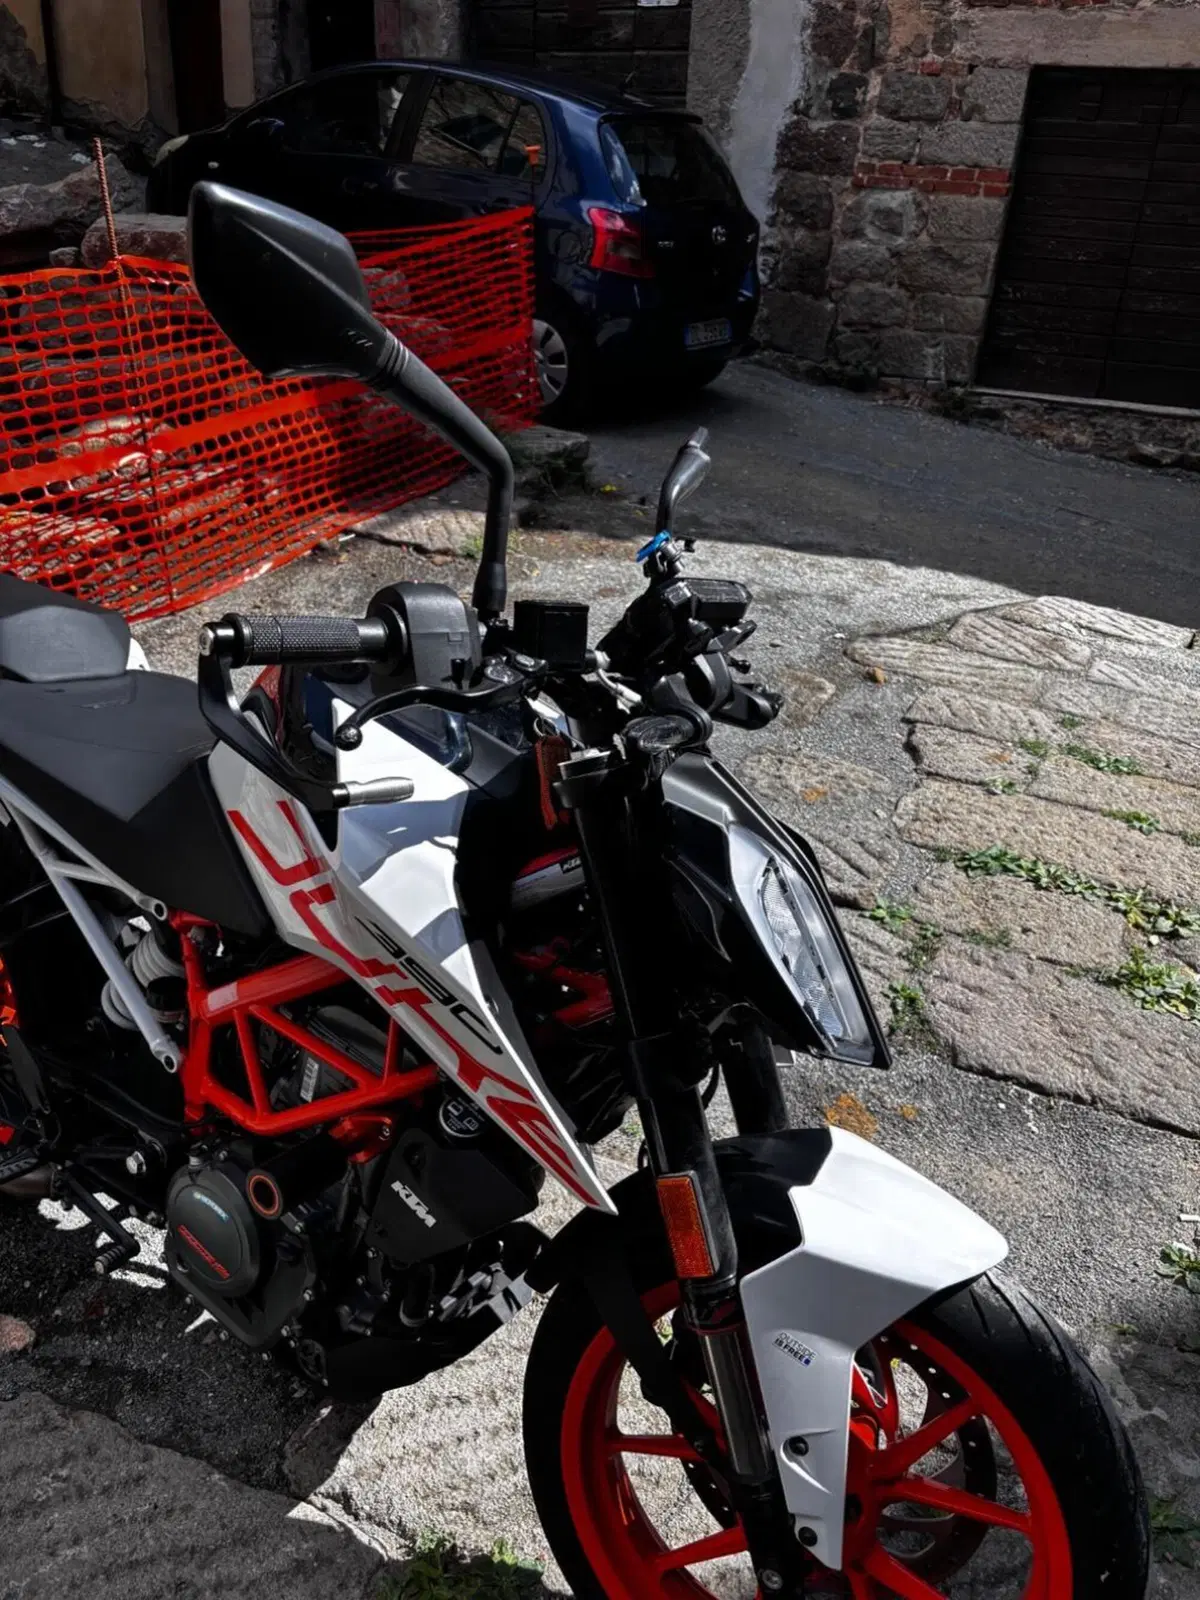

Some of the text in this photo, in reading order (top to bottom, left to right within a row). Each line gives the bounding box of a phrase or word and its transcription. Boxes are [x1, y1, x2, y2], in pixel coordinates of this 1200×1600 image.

[354, 916, 503, 1054] 390
[390, 1180, 437, 1228] KTM
[779, 1332, 817, 1360] OUTSIDE
[783, 1344, 804, 1362] FREE
